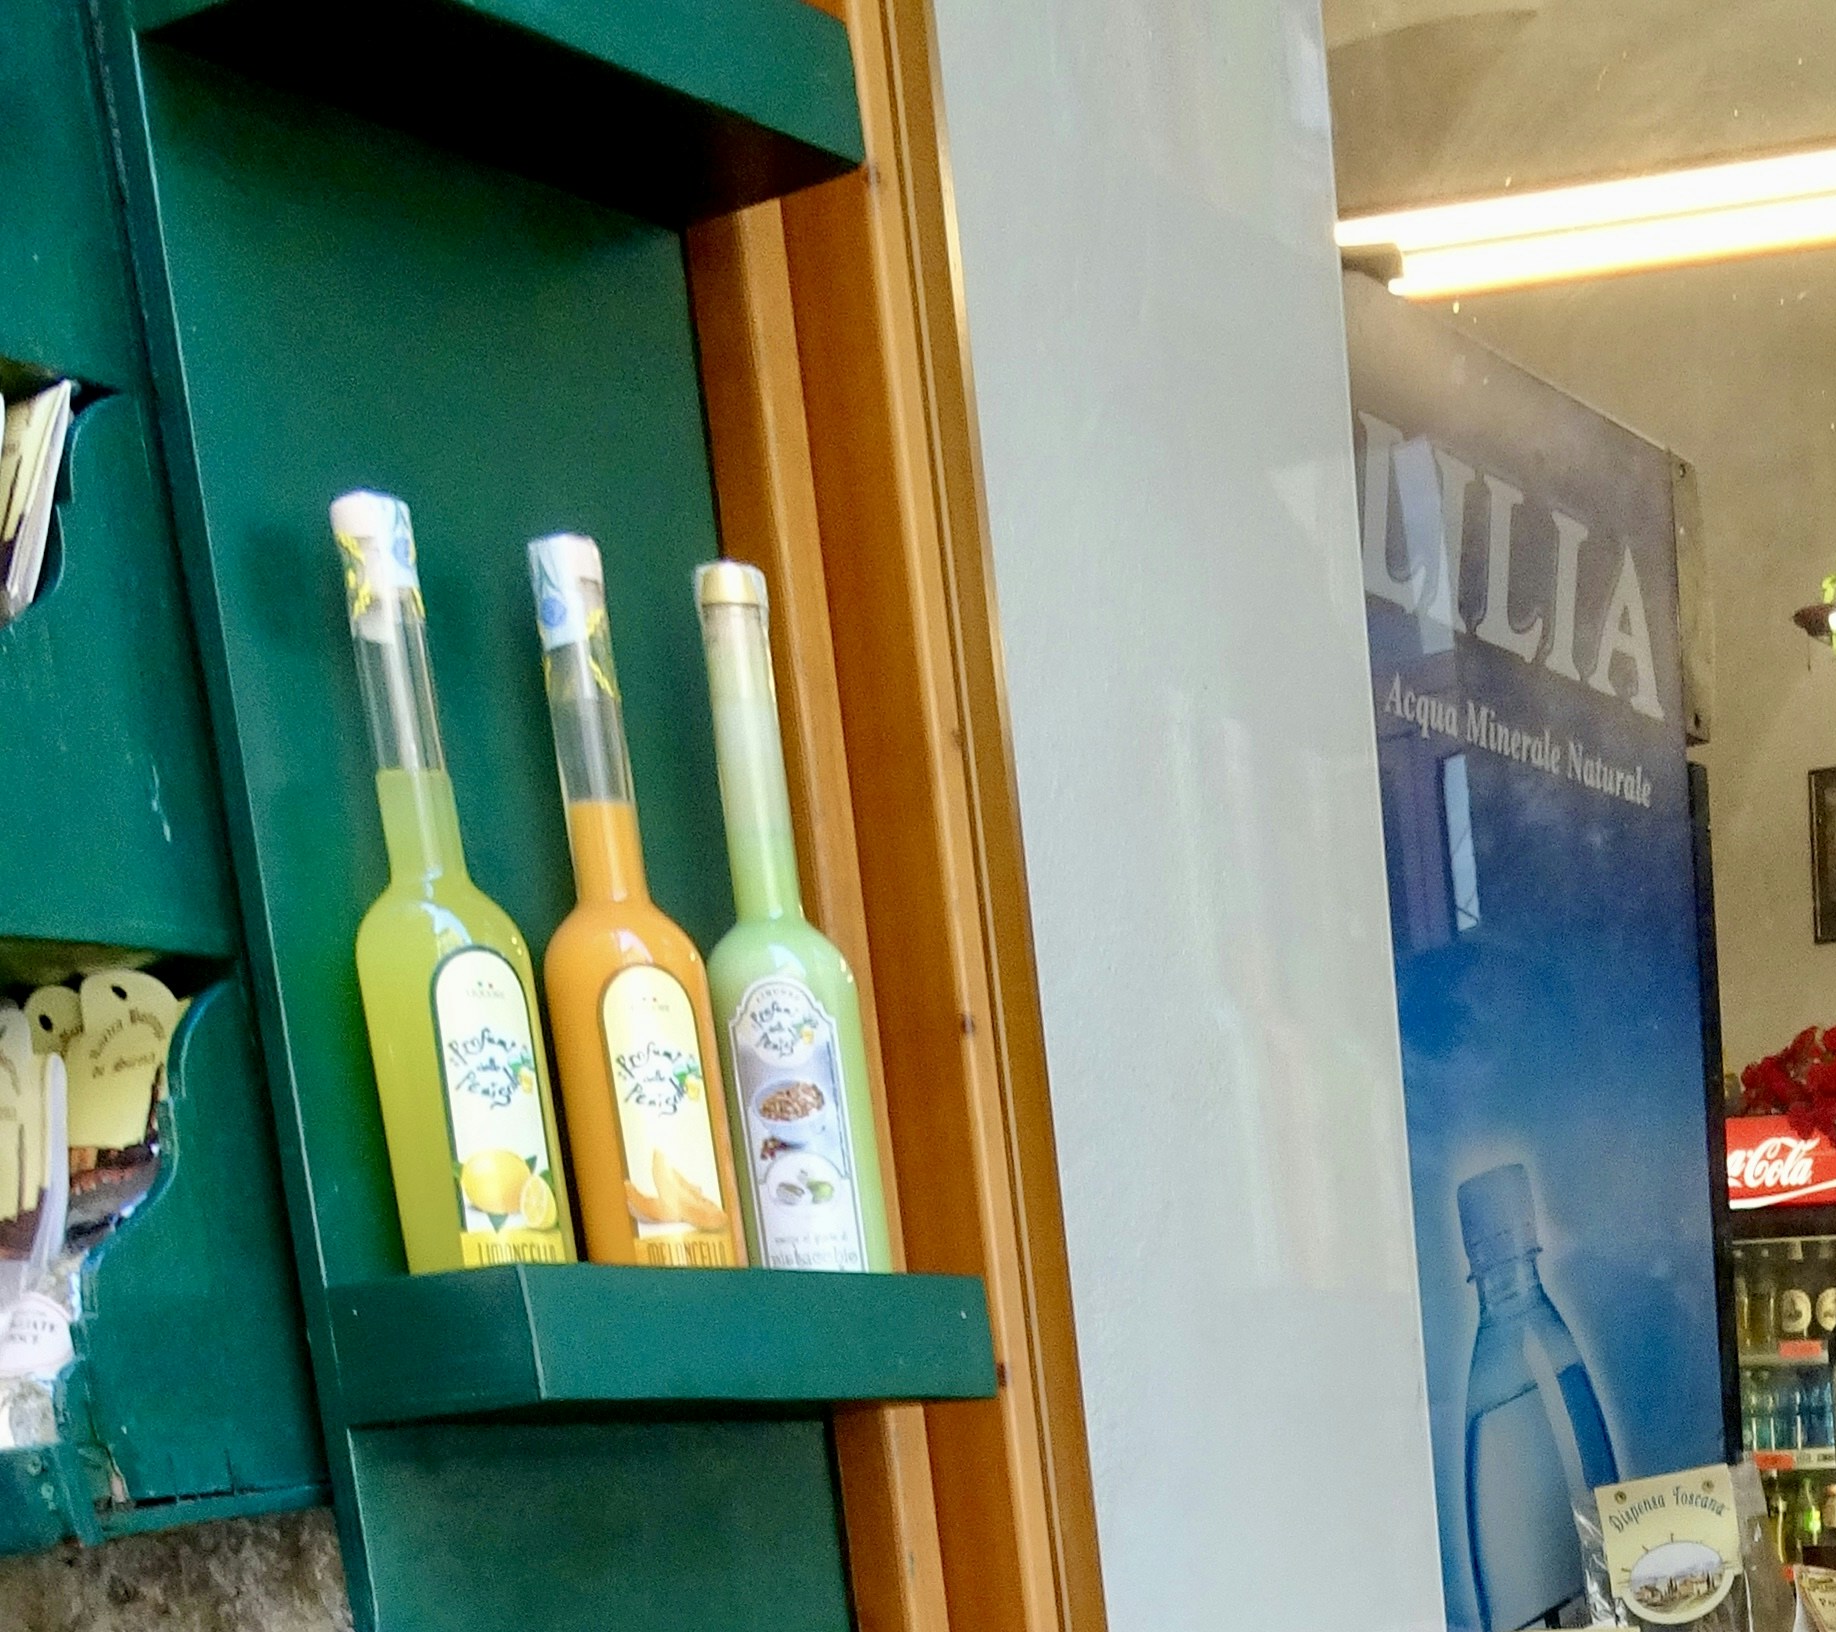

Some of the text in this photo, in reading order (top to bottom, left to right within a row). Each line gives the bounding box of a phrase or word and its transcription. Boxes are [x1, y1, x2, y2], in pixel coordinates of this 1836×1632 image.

[1385, 674, 1652, 809] Acqua Minerale Naturale
[1608, 1486, 1729, 1534] Dispensa Toscana
